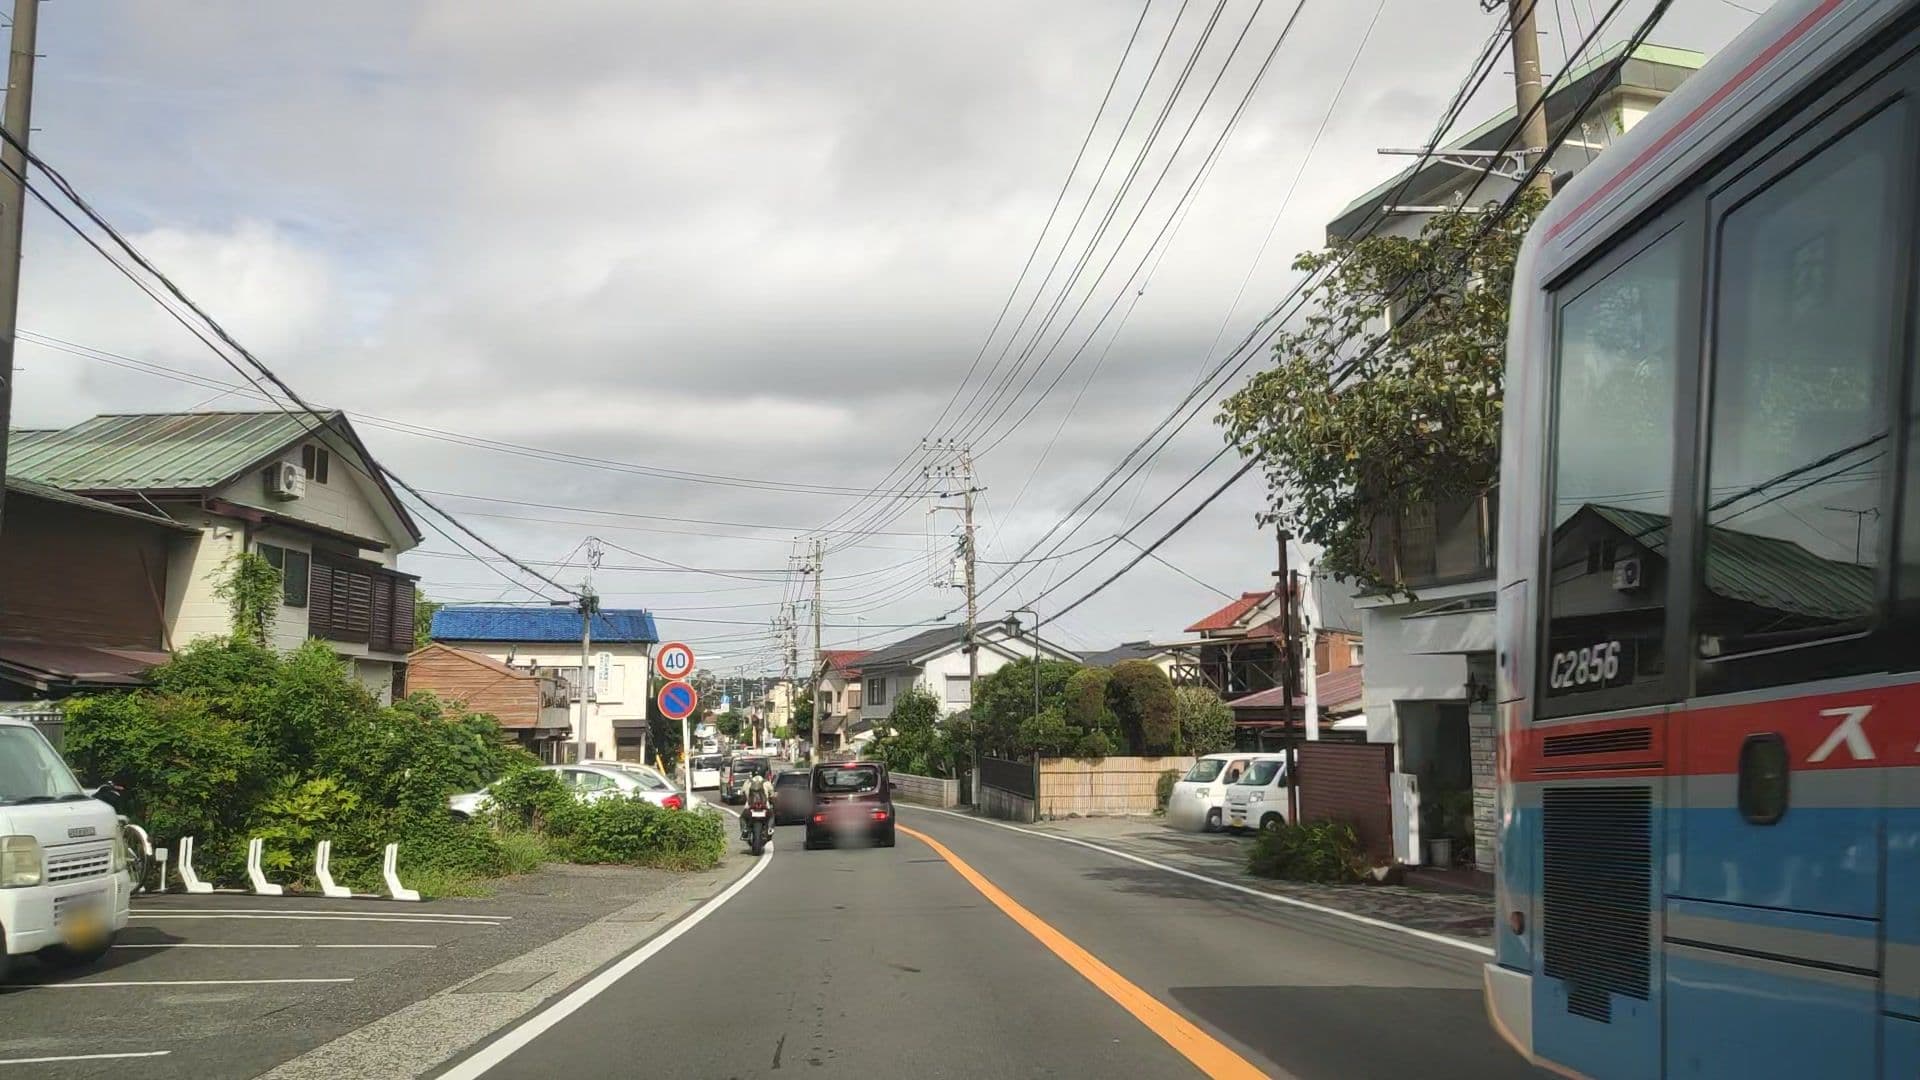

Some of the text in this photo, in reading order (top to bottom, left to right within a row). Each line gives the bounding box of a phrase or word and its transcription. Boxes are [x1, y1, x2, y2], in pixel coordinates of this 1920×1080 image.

[665, 652, 686, 669] 40
[1550, 641, 1621, 689] C2856
[1805, 704, 1920, 762] ス
